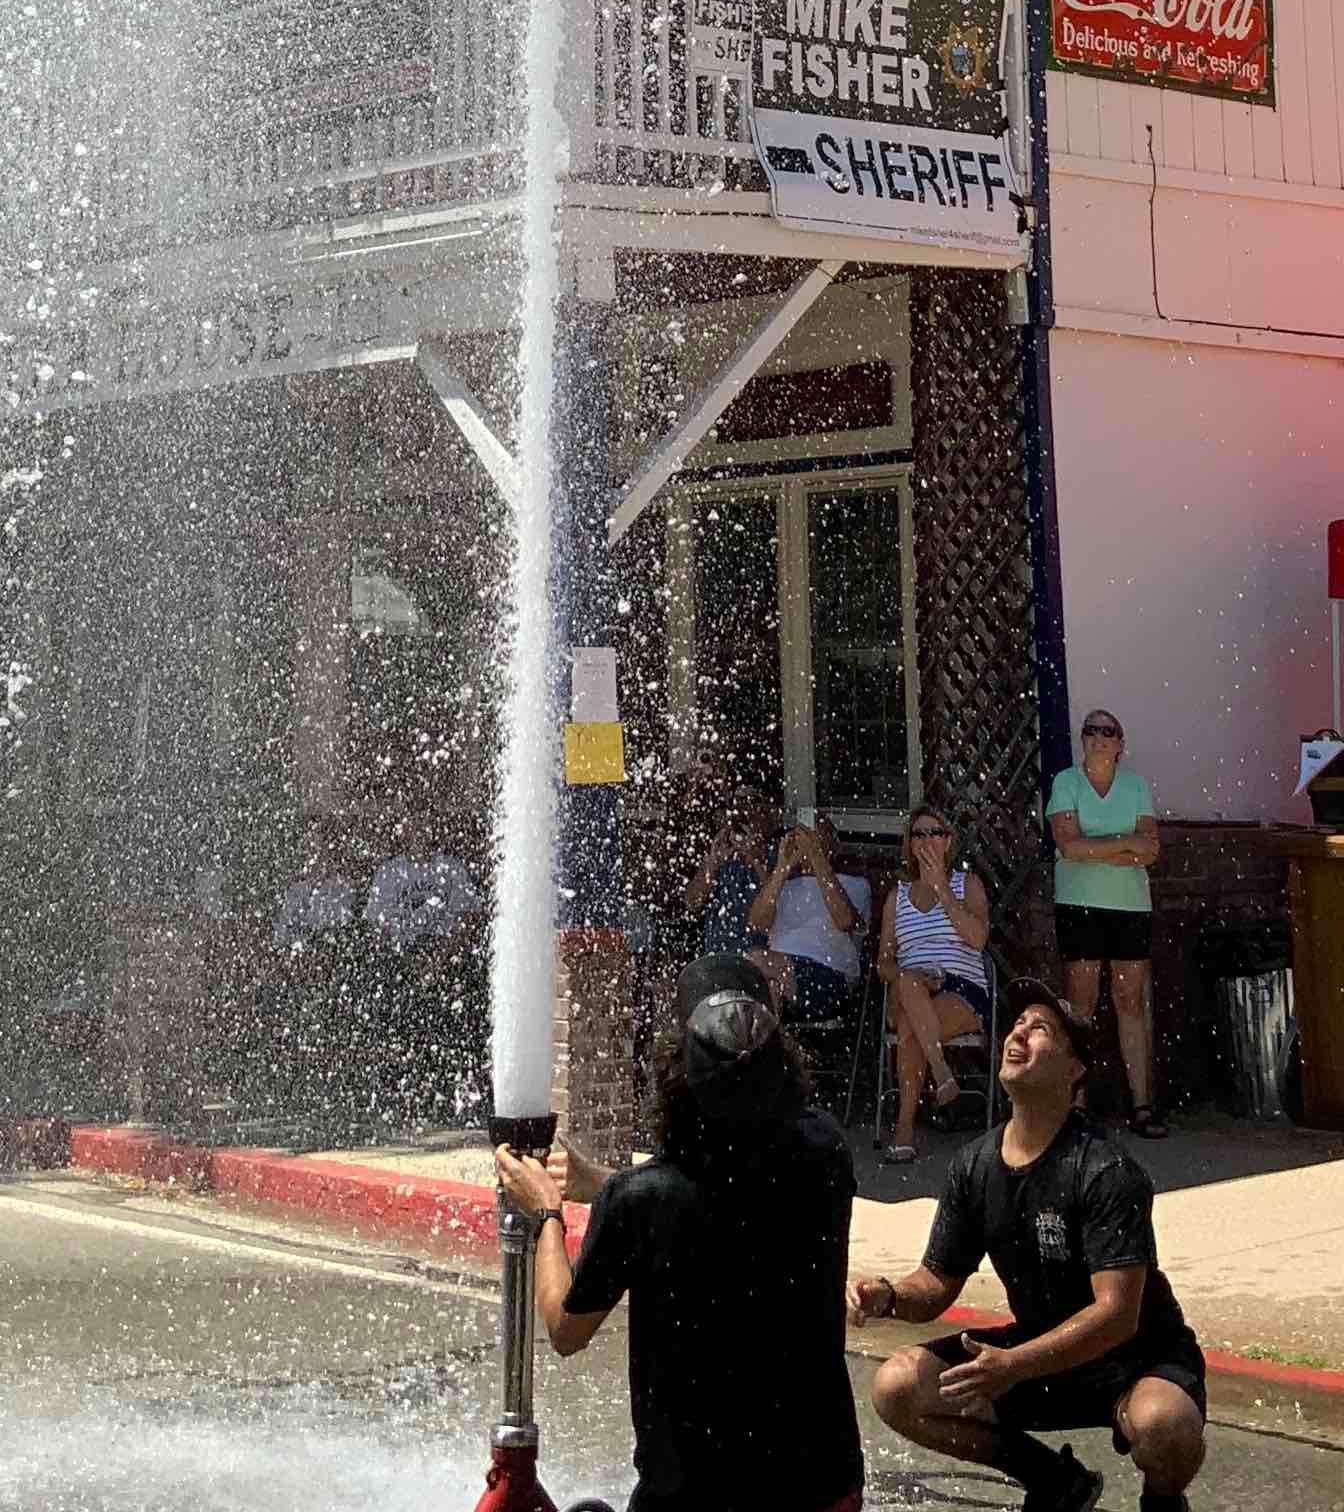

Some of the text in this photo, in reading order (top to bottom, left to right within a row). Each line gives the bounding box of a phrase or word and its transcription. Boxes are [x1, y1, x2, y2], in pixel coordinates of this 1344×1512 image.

[761, 38, 933, 111] FISHER
[1062, 18, 1260, 87] Delicious and Refreshing
[815, 133, 1006, 212] SHERIFF
